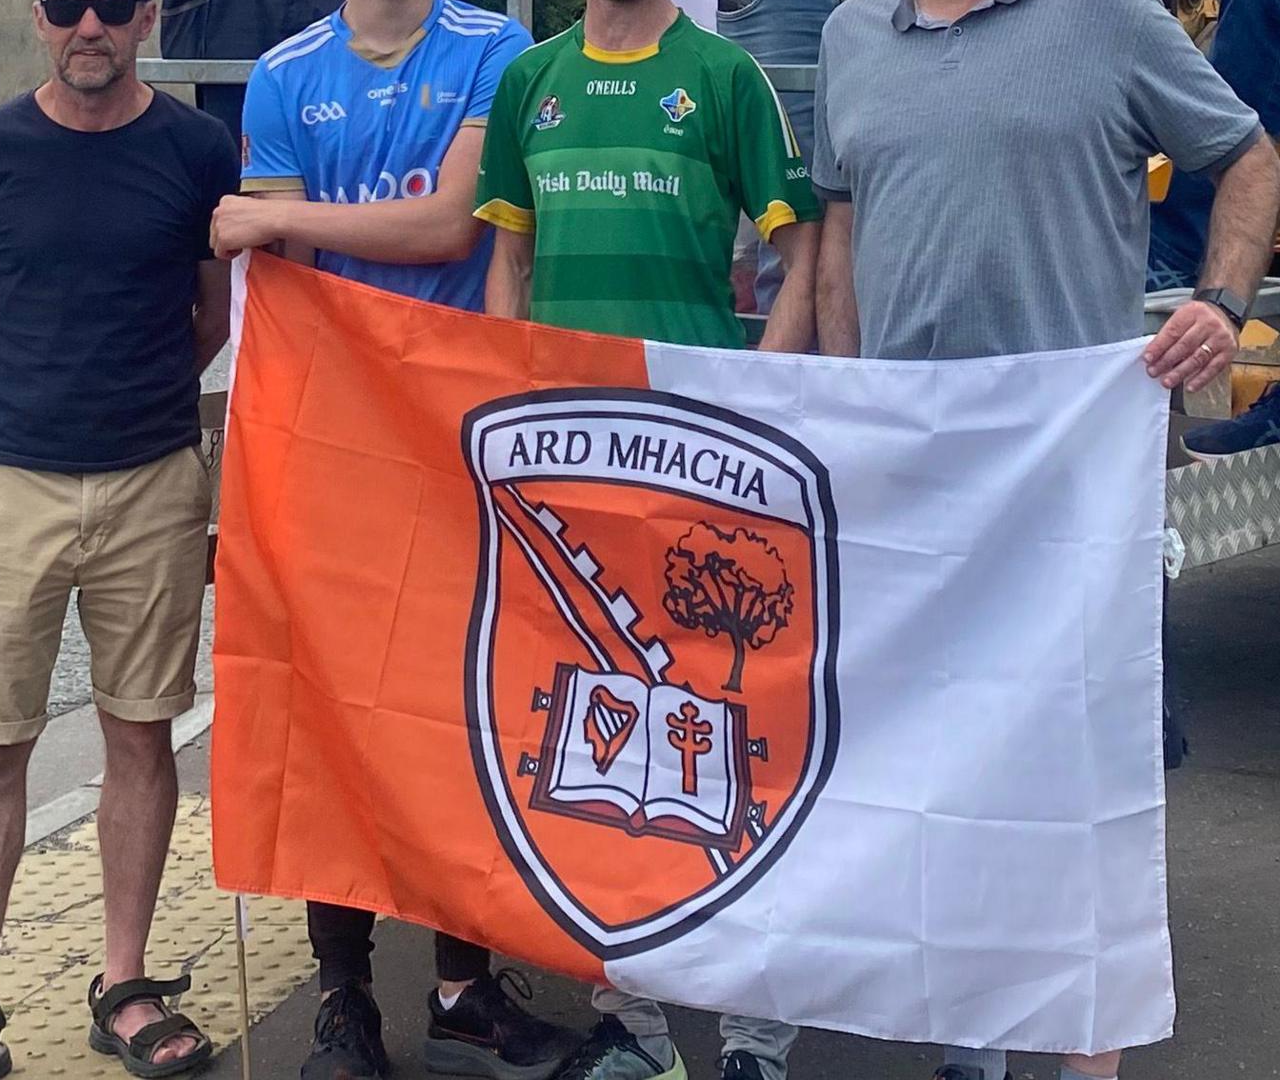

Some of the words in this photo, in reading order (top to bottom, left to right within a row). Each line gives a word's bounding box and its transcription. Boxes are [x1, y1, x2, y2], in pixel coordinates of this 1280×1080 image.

[586, 79, 637, 96] O'NEILLS
[536, 170, 570, 194] rish
[576, 170, 627, 198] Daily
[632, 170, 680, 196] Mail
[508, 430, 592, 467] ARD
[607, 431, 769, 507] MHACHA
